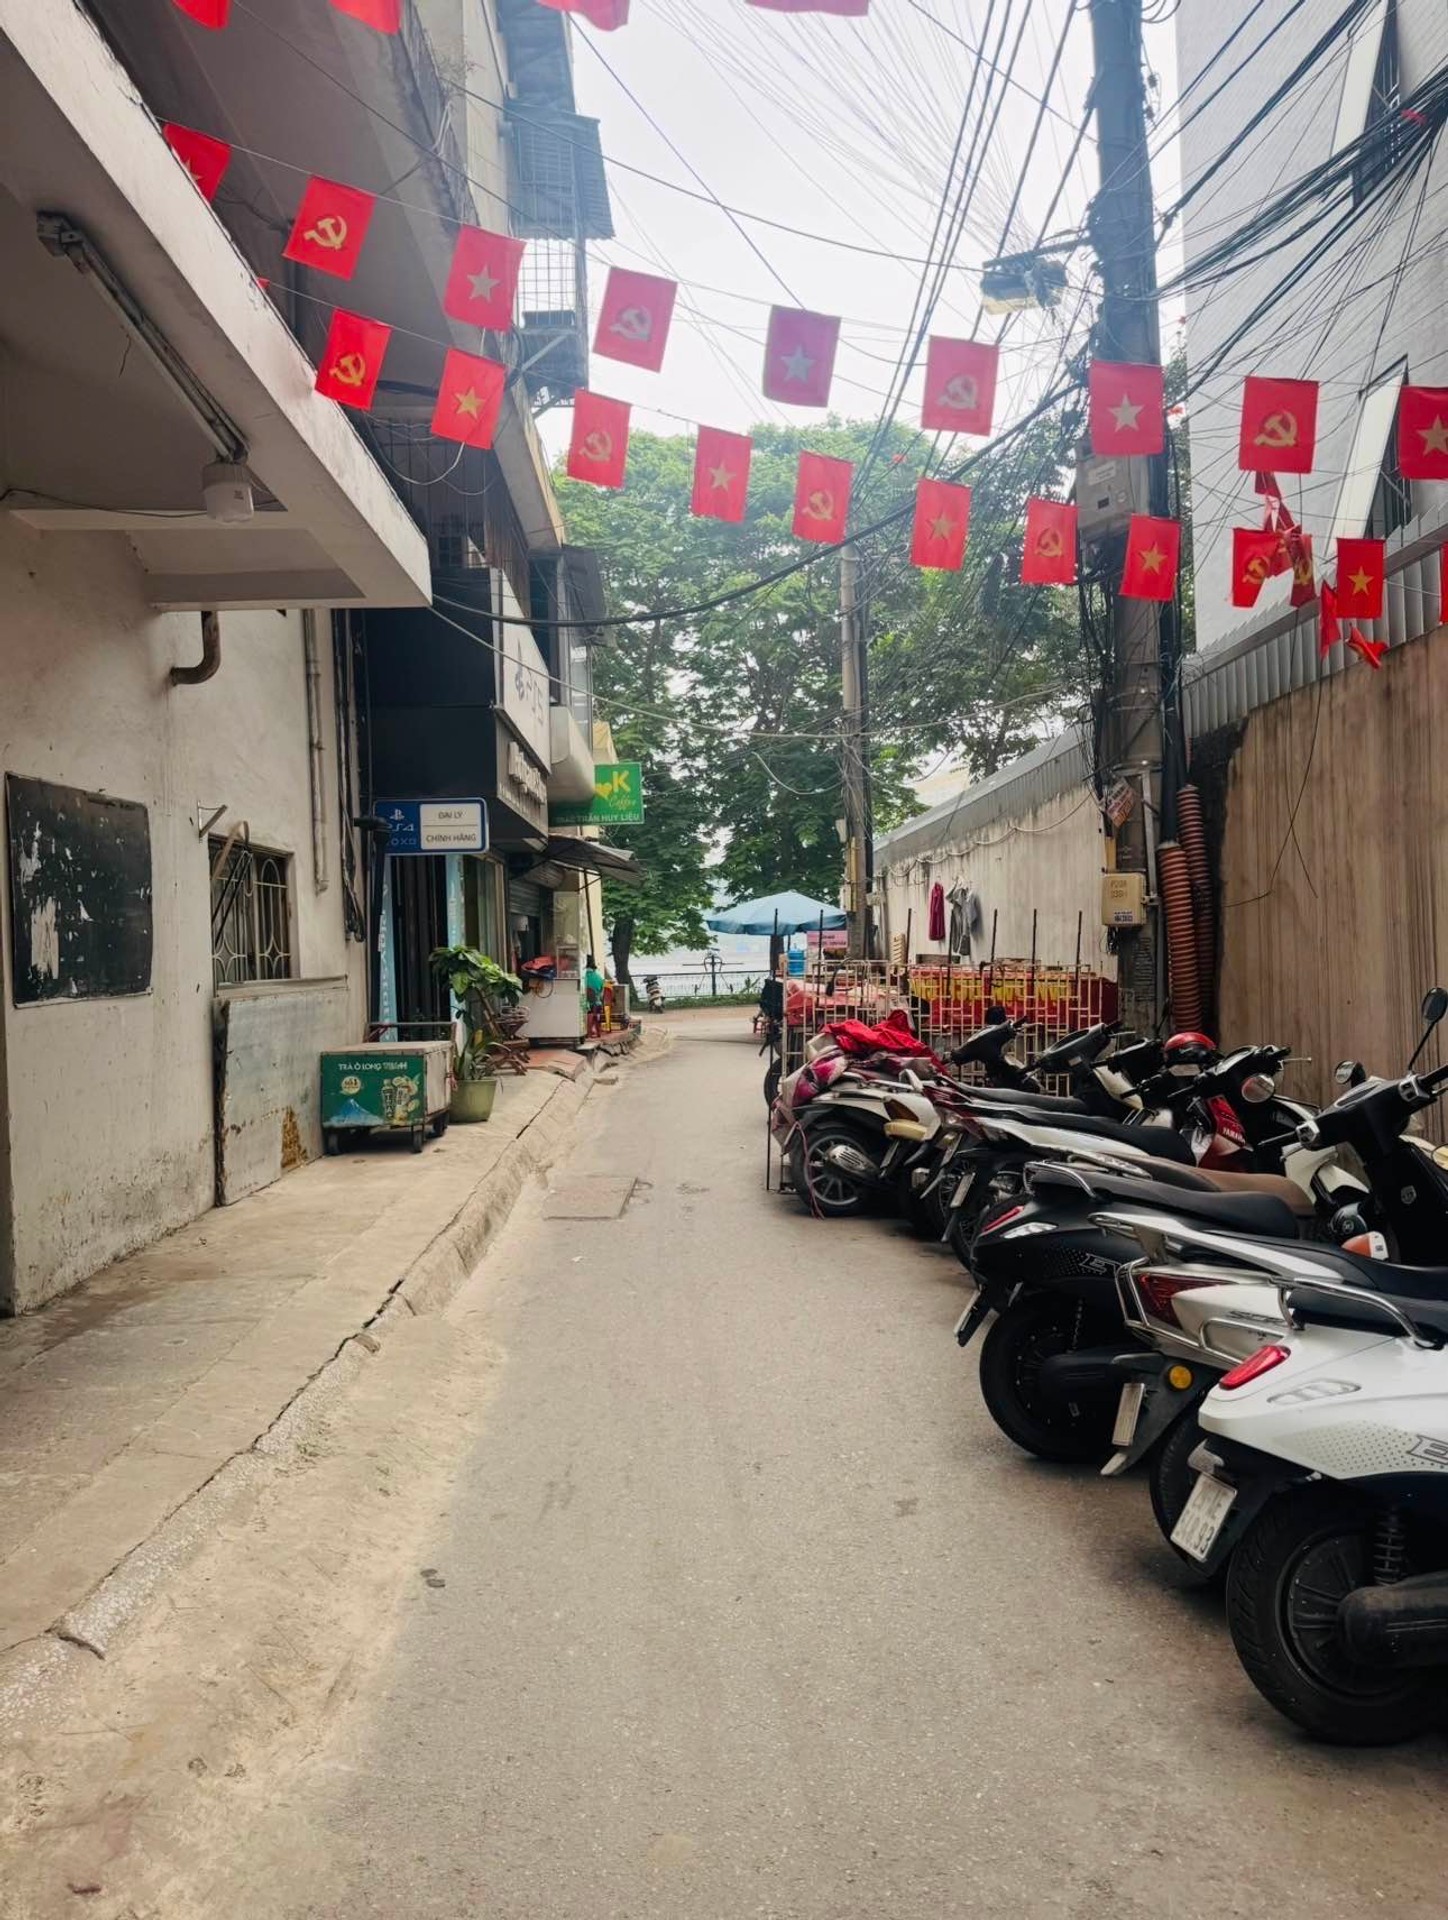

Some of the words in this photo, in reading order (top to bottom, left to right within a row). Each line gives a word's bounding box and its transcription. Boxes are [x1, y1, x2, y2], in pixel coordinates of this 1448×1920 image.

[612, 770, 632, 793] K
[602, 814, 619, 822] HUY
[362, 1062, 382, 1071] LONG
